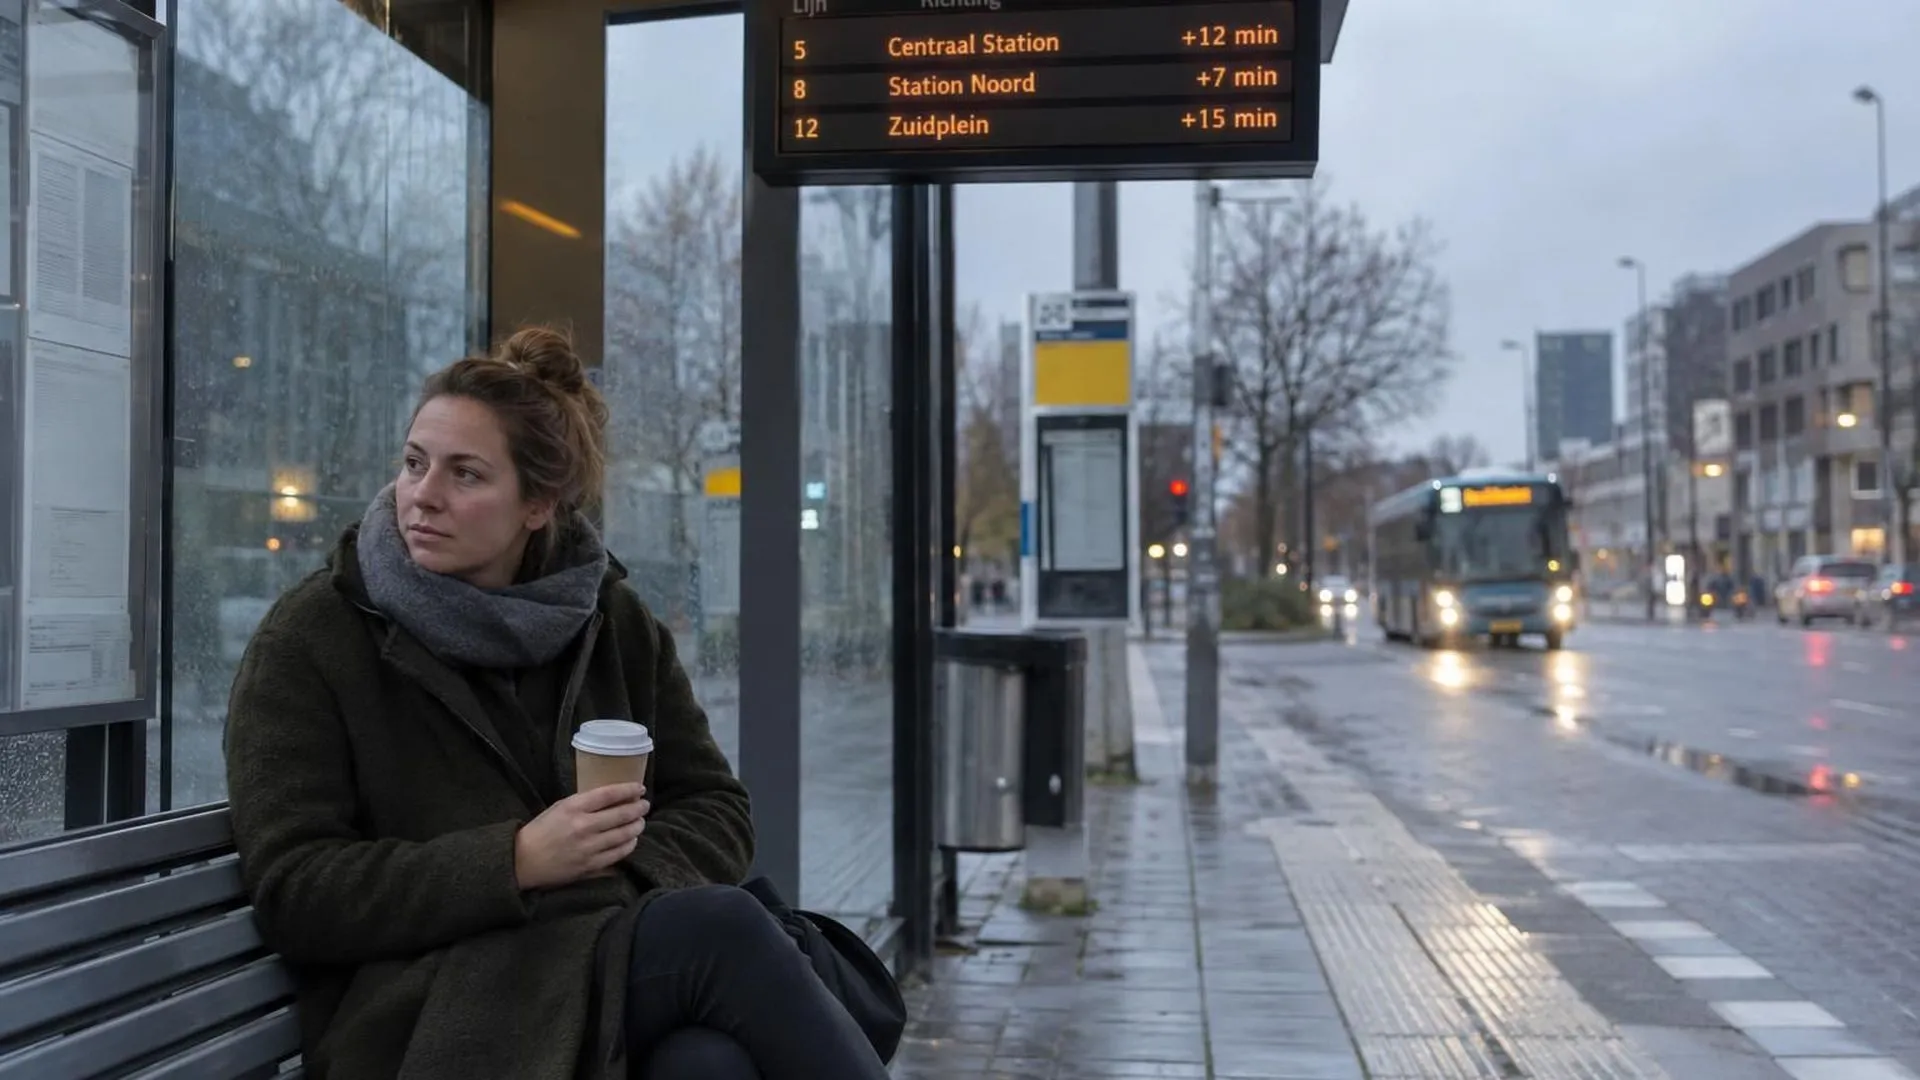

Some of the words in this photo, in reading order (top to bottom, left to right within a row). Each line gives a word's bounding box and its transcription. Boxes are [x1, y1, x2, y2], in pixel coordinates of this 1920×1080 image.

[888, 34, 976, 57] Centraal
[982, 32, 1061, 54] Station
[1181, 25, 1226, 47] +12
[1235, 24, 1278, 45] min
[794, 40, 807, 60] 5
[888, 75, 964, 97] Station
[970, 71, 1036, 94] Noord
[1196, 67, 1227, 88] +7
[1234, 65, 1277, 86] min
[794, 79, 807, 100] 8
[795, 118, 819, 139] 12
[888, 114, 990, 141] Zuidplein
[1181, 108, 1226, 129] +15
[1234, 107, 1277, 128] min
